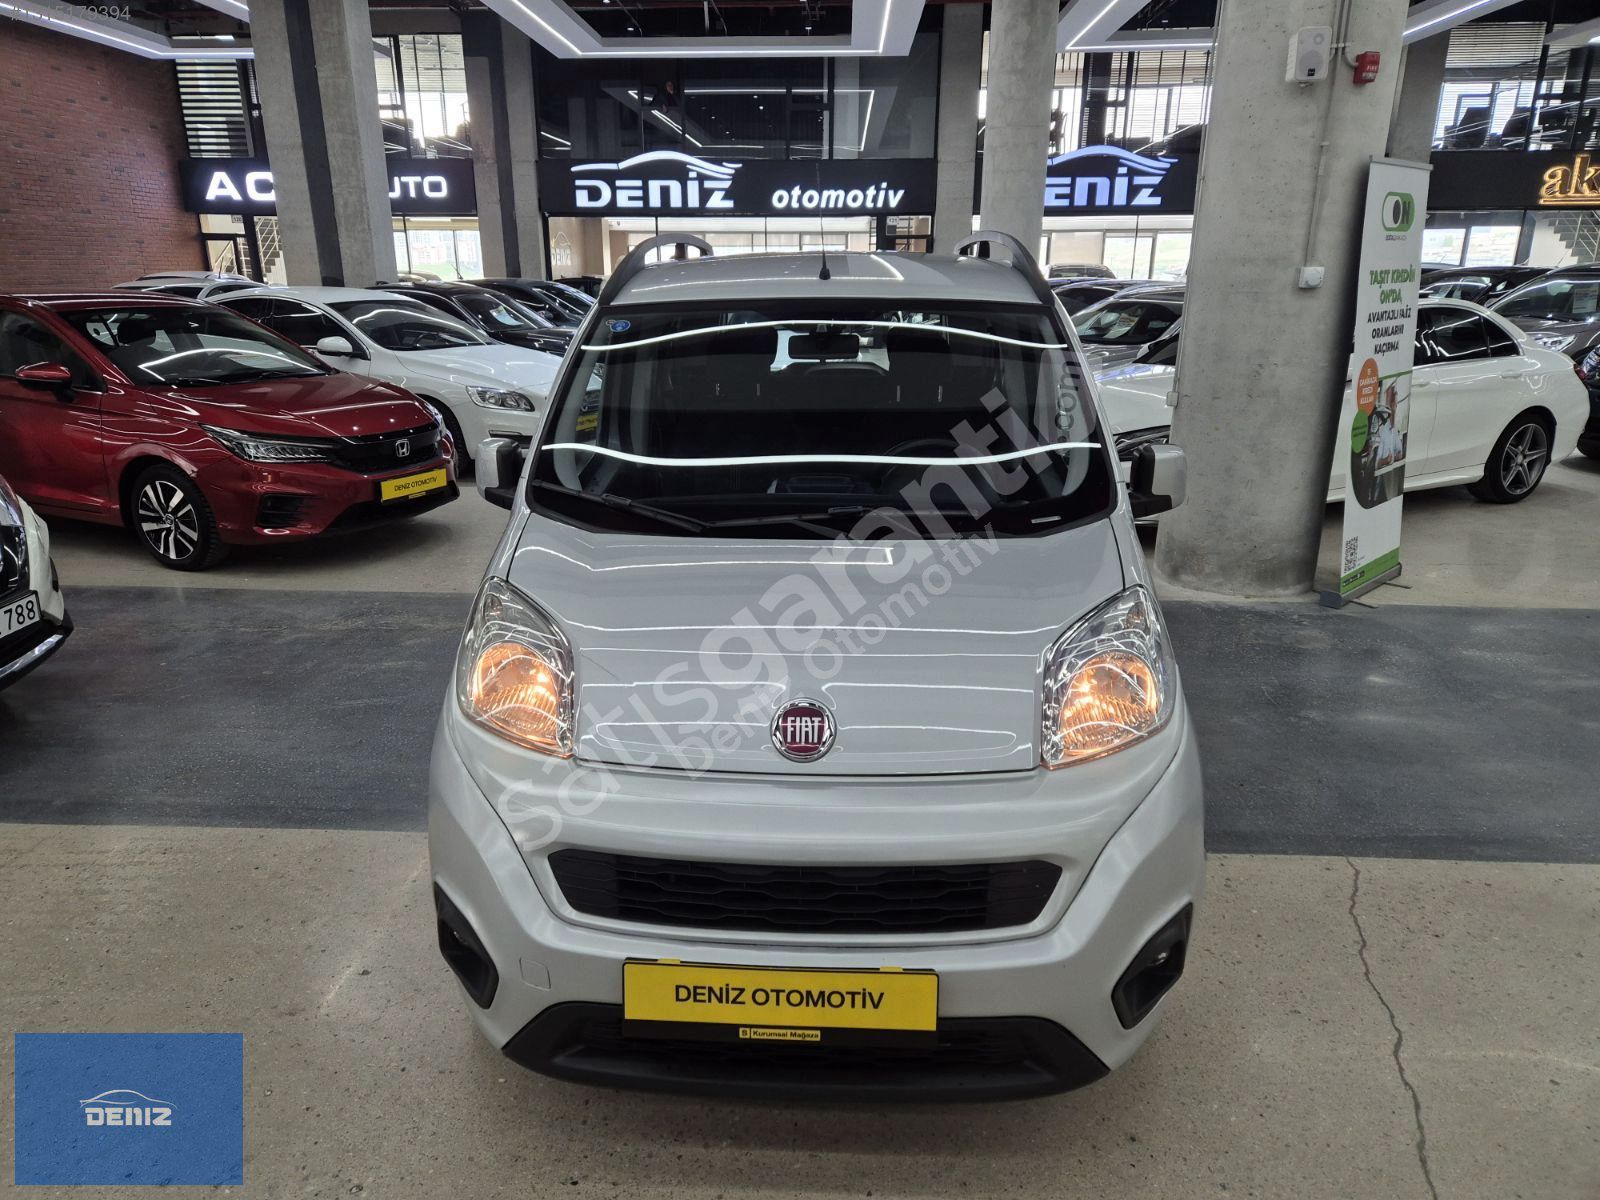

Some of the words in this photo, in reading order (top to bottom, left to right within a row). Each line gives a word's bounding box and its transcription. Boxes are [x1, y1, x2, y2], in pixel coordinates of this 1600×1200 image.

[771, 182, 905, 209] otomotiv
[1044, 166, 1163, 207] ENİZ
[1369, 269, 1391, 288] TAŞIT
[3, 600, 36, 630] 788
[787, 716, 822, 745] FIAT
[675, 983, 746, 1005] DENİZ
[752, 987, 884, 1009] OTOMOTİV
[752, 1029, 787, 1038] Kurumsal
[789, 1031, 819, 1040] Mağaza
